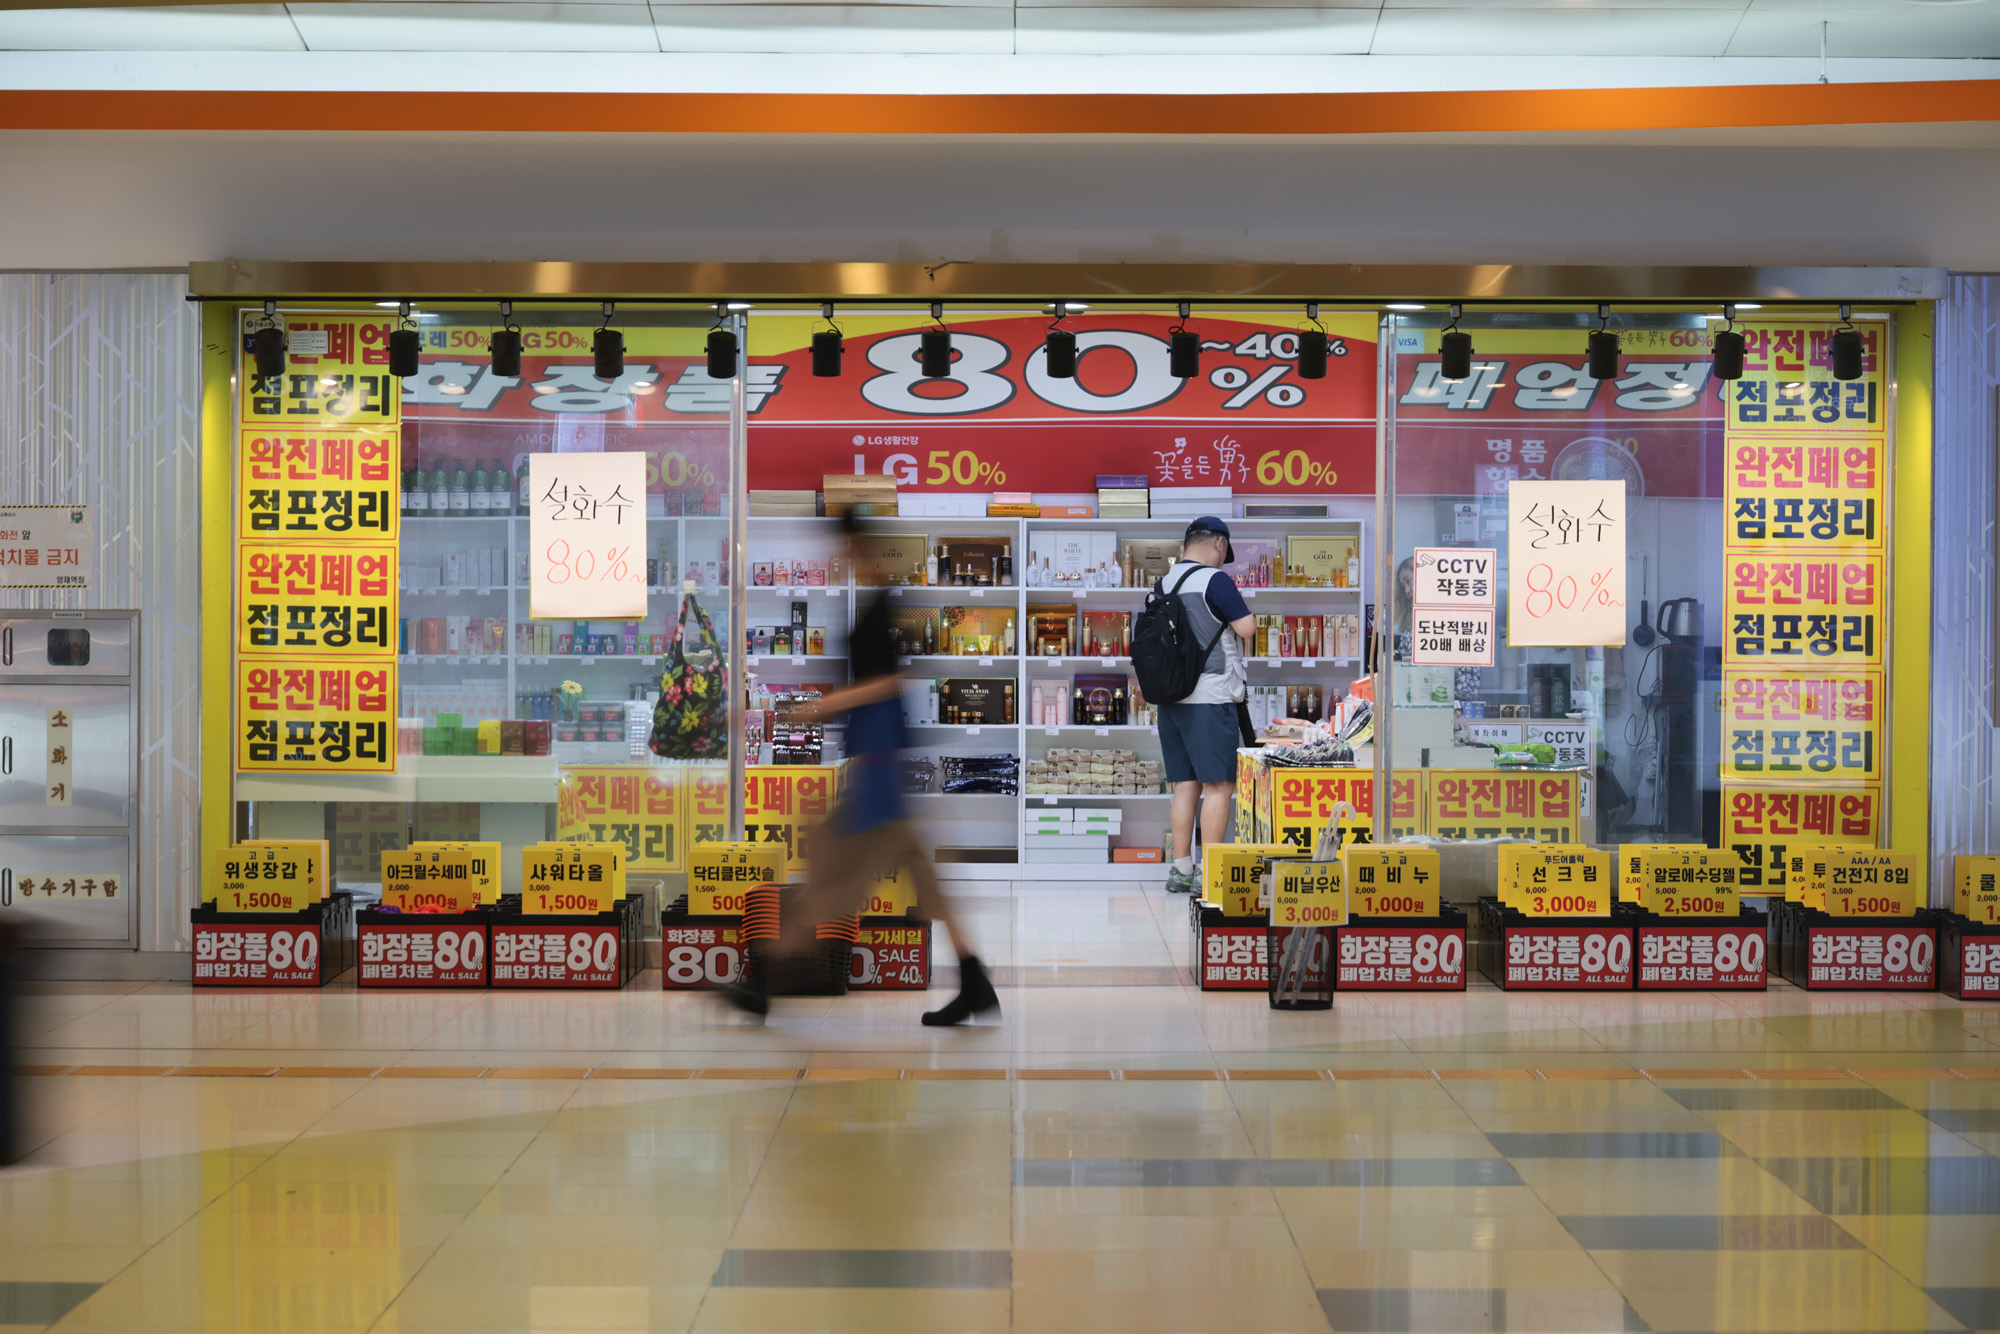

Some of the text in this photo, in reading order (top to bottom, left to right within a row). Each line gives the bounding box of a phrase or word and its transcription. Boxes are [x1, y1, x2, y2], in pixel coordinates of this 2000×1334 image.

[450, 331, 491, 348] 50%
[545, 332, 587, 348] 50%
[1398, 338, 1418, 346] VISA
[1670, 331, 1713, 347] 60%
[250, 374, 391, 416] 점포정리
[402, 361, 790, 413] 화장품
[1398, 361, 1726, 412] 폐업정
[1736, 380, 1876, 423] 점포정리
[867, 436, 918, 445] LG생활건강
[1486, 439, 1548, 463] 명품
[249, 440, 389, 482] 완전폐업
[646, 452, 715, 487] 50%
[926, 450, 1006, 486] 50%
[1256, 450, 1338, 486] 60%
[1735, 446, 1875, 489] 완전폐업
[541, 477, 637, 524] 설화수
[248, 490, 389, 532] 점포정리
[1734, 497, 1874, 540] 점포정리
[1520, 500, 1614, 549] 설화수
[0, 530, 31, 541] 화전 앞
[47, 549, 79, 566] 금지
[1436, 558, 1488, 574] CCTV
[247, 553, 387, 596] 완전폐업
[1733, 562, 1874, 605] 완전폐업
[1436, 577, 1489, 597] 작동중
[247, 604, 388, 648] 점포정리
[1418, 620, 1488, 637] 도난적발시
[1732, 614, 1873, 656] 점포정리
[1419, 637, 1486, 653] 20배 배상
[246, 667, 387, 712] 완전폐업
[1732, 678, 1873, 721] 완전폐업
[245, 720, 386, 763] 점포정리
[1543, 731, 1586, 744] CCTV
[51, 711, 70, 801] 소화기
[1555, 747, 1586, 762] 동중
[1731, 729, 1873, 772] 점포정리
[1436, 778, 1570, 818] 완전폐업
[1731, 792, 1872, 836] 완전폐업
[1544, 855, 1584, 864] 푸드어홀릭
[1851, 857, 1891, 865] AAA AA
[225, 862, 298, 880] 위생장갑
[387, 864, 467, 881] 아크릴수세미
[530, 864, 604, 882] 샤워타올
[694, 866, 775, 882] 닥터클린칫솔
[1359, 866, 1429, 884] 때비누
[1532, 866, 1597, 883] 선크림
[1654, 868, 1735, 883] 알로에수딩젤
[1832, 867, 1908, 884] 건전지 8입
[18, 878, 120, 899] 방수기구함
[223, 883, 245, 891] 3,000
[529, 884, 551, 892] 3,000
[1284, 876, 1341, 895] 비닐우산
[1655, 887, 1677, 895] 5,000
[1832, 887, 1853, 895] 3,500
[233, 892, 292, 910] 1,500원
[398, 894, 457, 911] 1,000원
[538, 895, 598, 912] 1,500원
[712, 896, 745, 911] 500
[1365, 897, 1424, 914] 1,000원
[1533, 896, 1597, 914] 3,000원
[1664, 897, 1724, 914] 2,500원
[1841, 897, 1901, 914] 1,500원
[1286, 906, 1339, 923] 3,000원
[196, 930, 268, 961] 화장품
[667, 929, 716, 944] 화장품
[859, 930, 922, 945] 특가세일
[267, 930, 318, 971] 80%
[362, 932, 433, 963] 화장품
[433, 931, 484, 971] 80%
[494, 933, 567, 964] 화장품
[566, 932, 618, 972] 80%
[878, 949, 920, 963] SALE
[1206, 933, 1278, 965] 화장품
[1340, 934, 1412, 966] 화장품
[1412, 934, 1464, 974] 80%
[1508, 935, 1581, 965] 화장품
[1580, 934, 1632, 974] 80%
[1642, 934, 1714, 965] 화장품
[1714, 933, 1765, 973] 80%
[1811, 934, 1884, 965] 화장품
[1883, 933, 1934, 974] 80%
[196, 963, 267, 978] 폐업처분
[362, 965, 434, 980] 폐업처분
[494, 966, 567, 981] 폐업처분
[667, 945, 747, 984] 80%
[850, 947, 883, 984] 0%
[1641, 966, 1714, 981] 폐업처분
[1811, 966, 1883, 981] 폐업처분
[273, 972, 314, 980] ALL SALE
[440, 972, 481, 981] ALL SALE
[572, 973, 613, 982] ALL SALE
[1206, 966, 1278, 982] 폐업처분
[1340, 967, 1412, 982] 폐업처분
[1418, 975, 1458, 983] ALL SALE
[1508, 966, 1580, 982] 폐업처분
[1585, 975, 1627, 983] ALL SALE
[1719, 975, 1760, 983] ALL SALE
[1888, 975, 1929, 983] ALL SALE
[1964, 976, 2000, 991] 폐업
